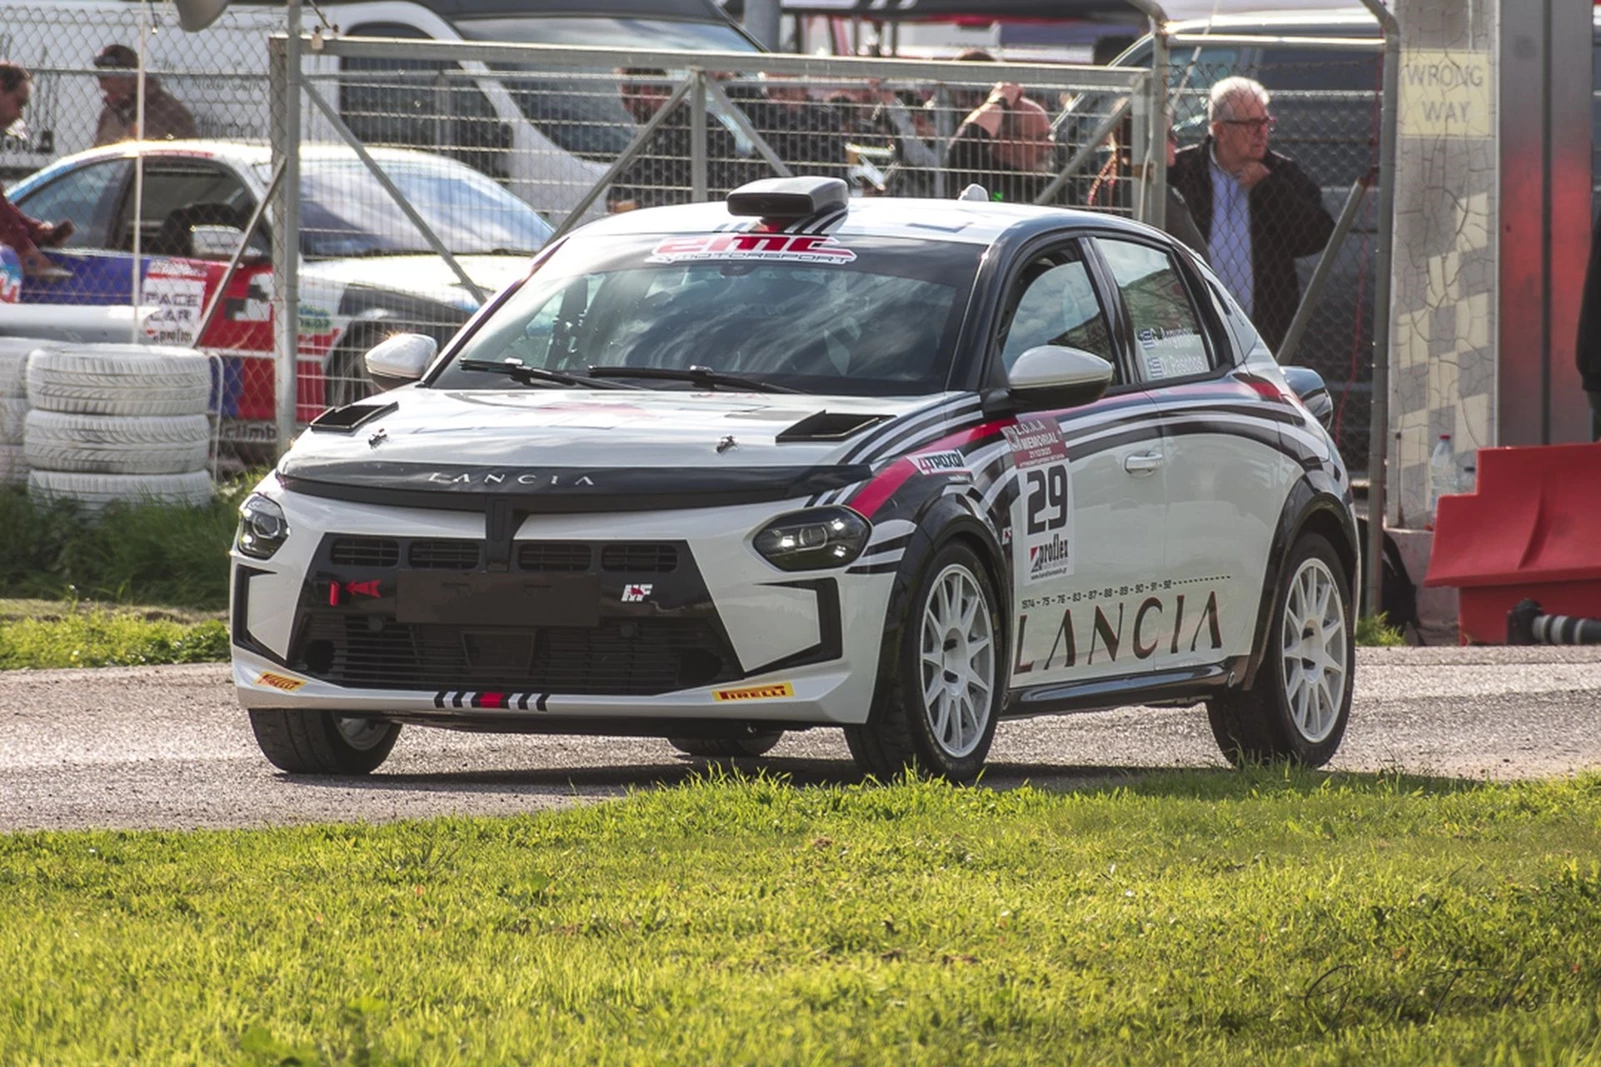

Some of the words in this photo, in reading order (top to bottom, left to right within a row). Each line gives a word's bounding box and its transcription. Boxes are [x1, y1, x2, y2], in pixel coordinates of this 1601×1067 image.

[1405, 65, 1484, 87] WRONG
[1421, 101, 1470, 123] WAY
[145, 291, 199, 307] PACE
[150, 308, 192, 324] CAR
[1020, 432, 1060, 451] MEMORIAL
[428, 472, 594, 486] LANCIA
[1027, 464, 1068, 536] 29
[1036, 533, 1069, 573] proflex
[1042, 596, 1050, 606] 75
[1072, 592, 1081, 602] 83
[1088, 590, 1098, 600] 87
[1013, 591, 1223, 675] LANCIA
[718, 685, 787, 700] PIRELLI
